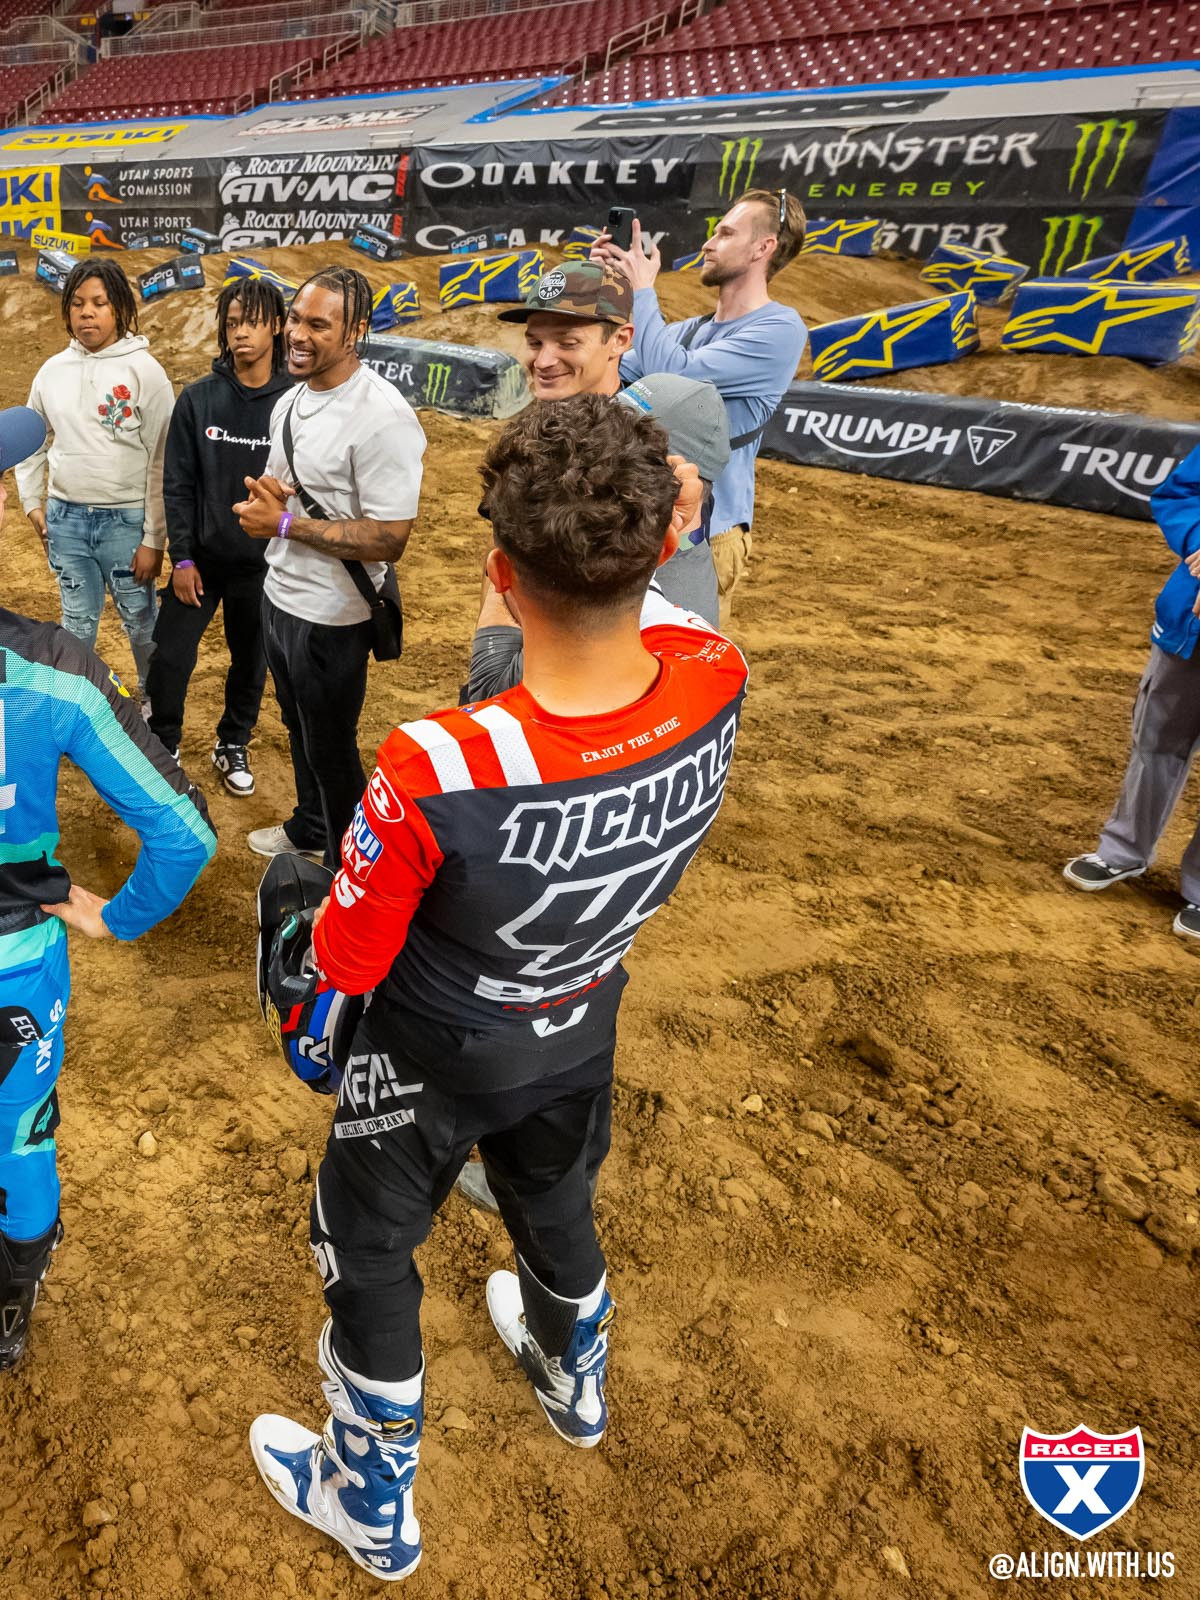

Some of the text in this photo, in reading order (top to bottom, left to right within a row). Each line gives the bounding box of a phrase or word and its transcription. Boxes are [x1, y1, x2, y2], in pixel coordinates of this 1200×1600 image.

[120, 167, 193, 181] UTAH SPORTS
[245, 154, 398, 175] ROCKY MOUNTAIN
[482, 158, 680, 185] OAKLEY
[120, 183, 192, 197] COMMISSION
[808, 181, 985, 198] ENERGY
[120, 217, 192, 228] UTAH SPORTS
[243, 210, 294, 229] ROCKY
[34, 235, 75, 252] SUZUKI
[356, 231, 388, 251] GoPro
[451, 232, 487, 249] GoPro
[141, 268, 174, 288] GoPro
[784, 408, 961, 458] TRIUMPH
[1059, 443, 1180, 497] TRIU
[581, 716, 681, 763] ENJOY THE RIDE
